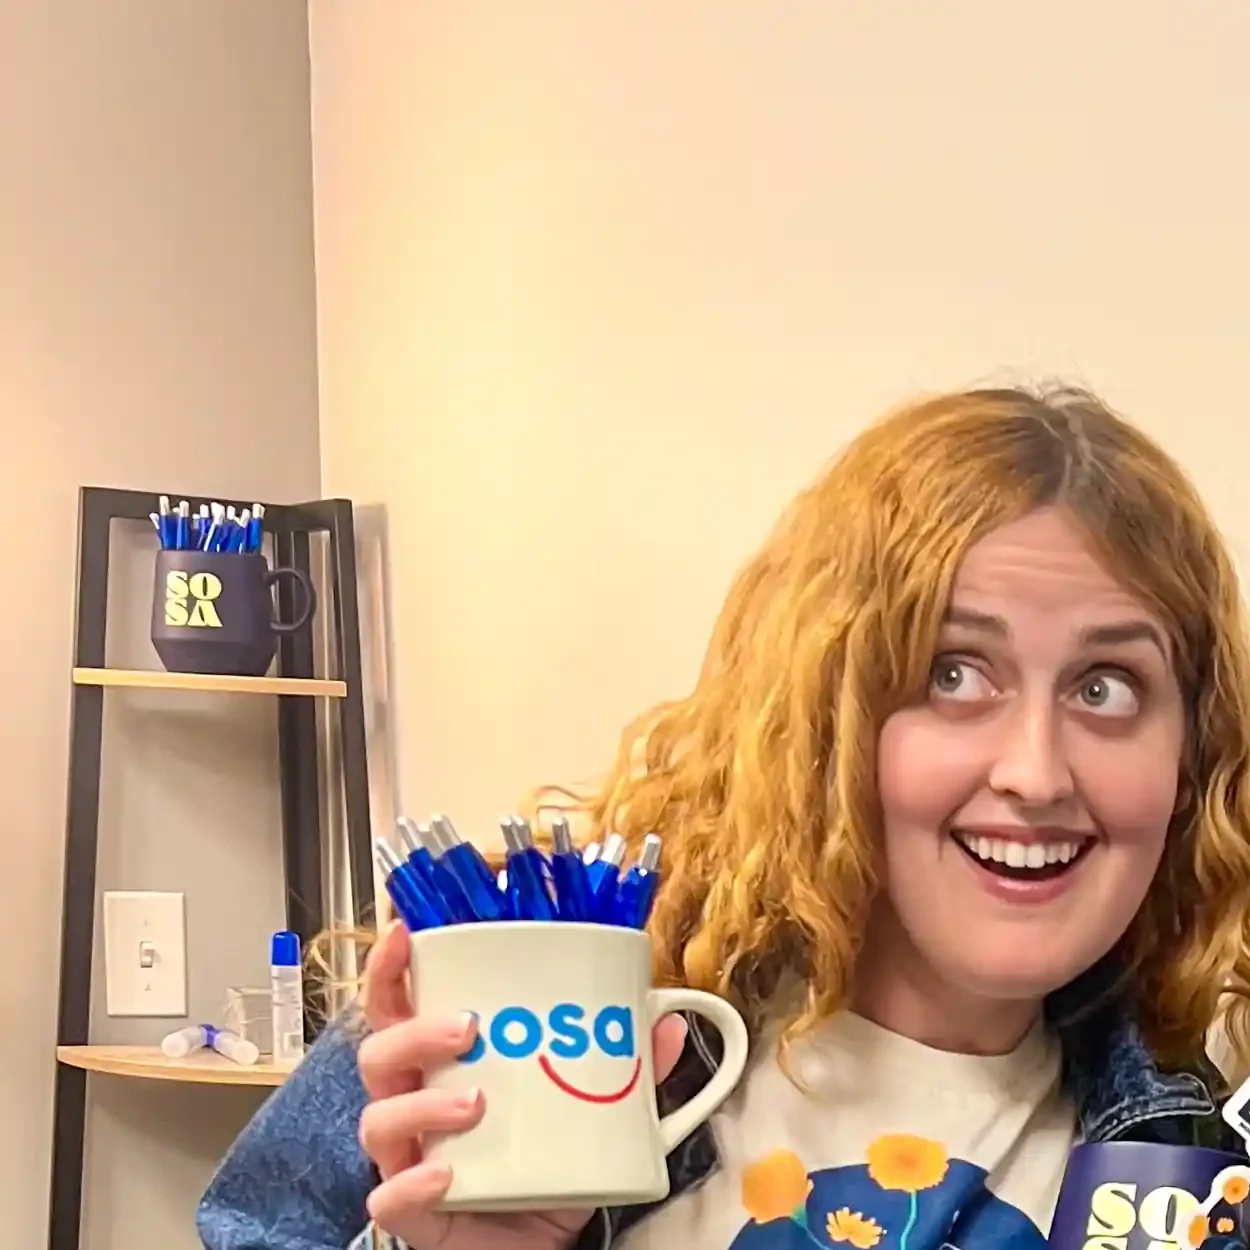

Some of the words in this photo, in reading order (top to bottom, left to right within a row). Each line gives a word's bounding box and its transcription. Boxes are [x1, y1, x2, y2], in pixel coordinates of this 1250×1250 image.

[166, 570, 222, 599] SO
[165, 599, 223, 627] SA
[1086, 1182, 1201, 1243] SO
